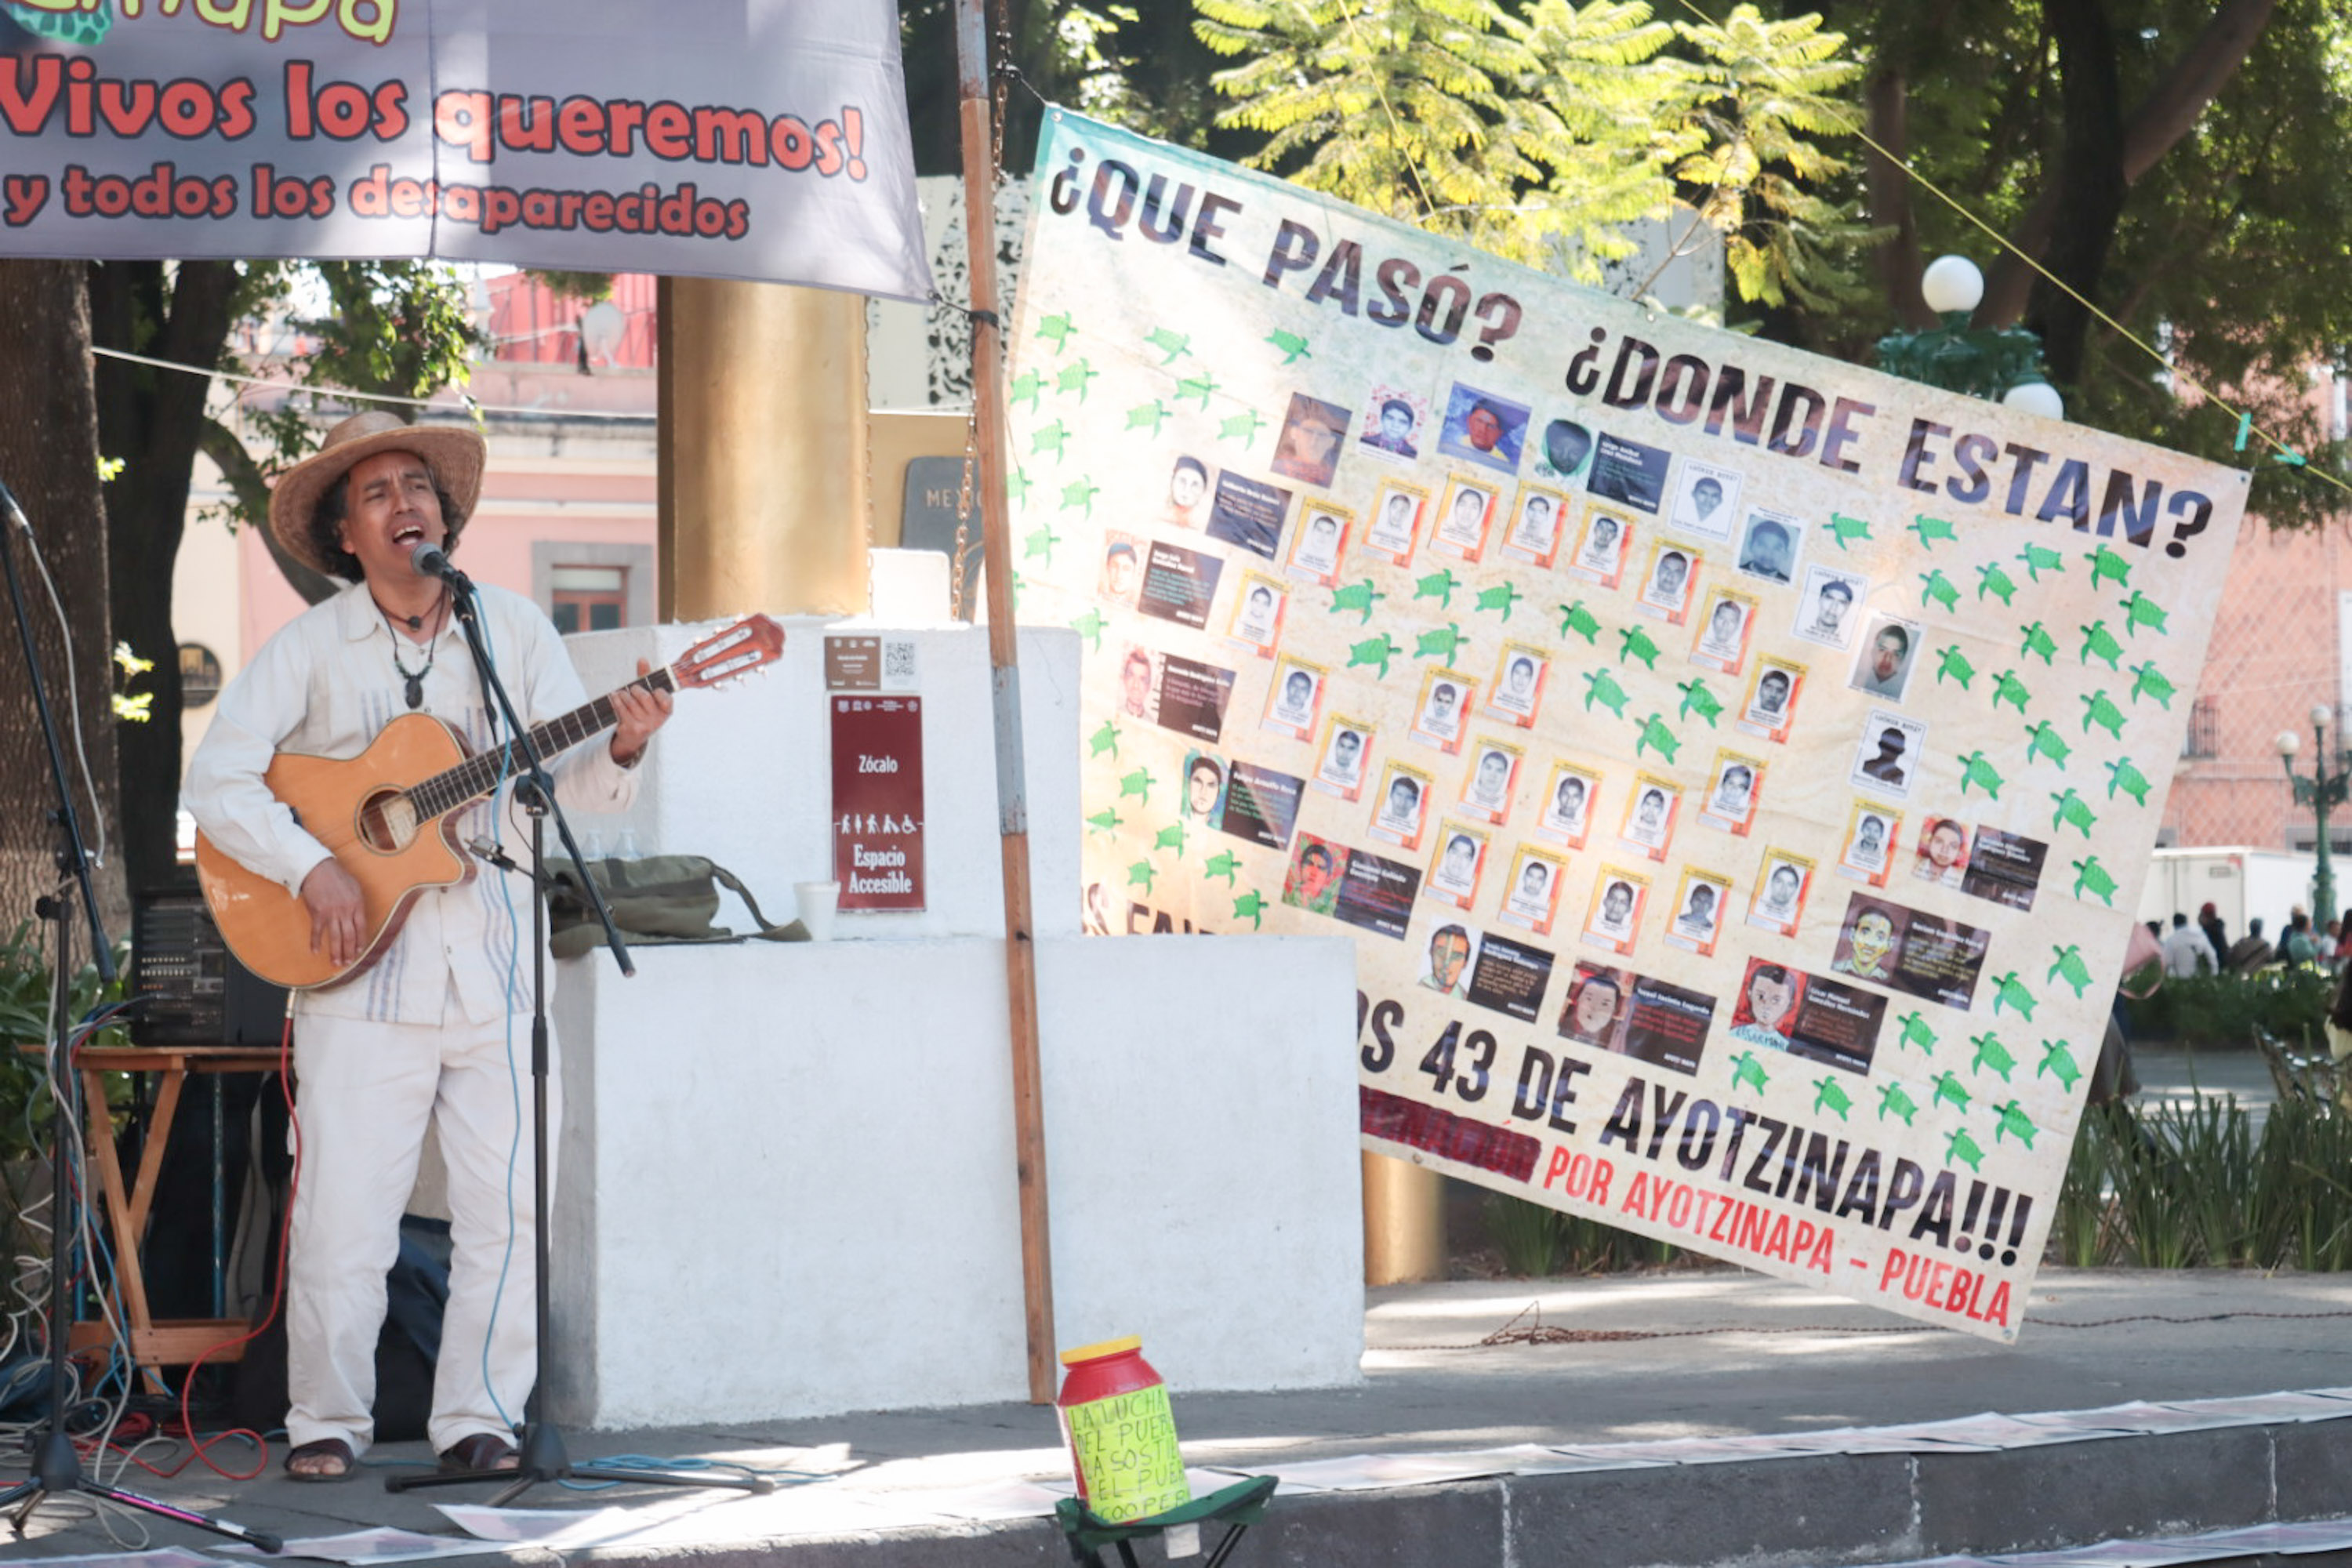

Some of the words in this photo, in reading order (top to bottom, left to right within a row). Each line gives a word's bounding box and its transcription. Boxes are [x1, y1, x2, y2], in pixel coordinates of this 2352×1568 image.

[0, 54, 257, 140] Vivos
[283, 58, 410, 143] los
[432, 88, 869, 183] queremos!
[3, 171, 49, 227] y
[64, 162, 238, 219] todos
[251, 163, 336, 220] los
[348, 164, 750, 241] desaparecidos
[1049, 147, 1243, 267] ¿QUE
[1262, 217, 1523, 363] PASÓ?
[1566, 326, 1877, 474] ¿DONDE
[1897, 416, 2213, 559] ESTAN?
[858, 754, 898, 773] Zócalo
[848, 870, 913, 894] Accesible
[853, 843, 906, 871] Espacio
[1418, 1019, 1497, 1102] 43
[1511, 1044, 1592, 1134] DE
[1598, 1076, 2034, 1268] AYOTZINAPA!!!
[1543, 1145, 1614, 1207] POR
[1621, 1171, 1836, 1276] AYOTZINAPA
[1879, 1247, 2011, 1329] PUEBLA
[1071, 1406, 1094, 1431] LA
[1101, 1388, 1165, 1425] LUCHA
[1098, 1477, 1122, 1501] EL
